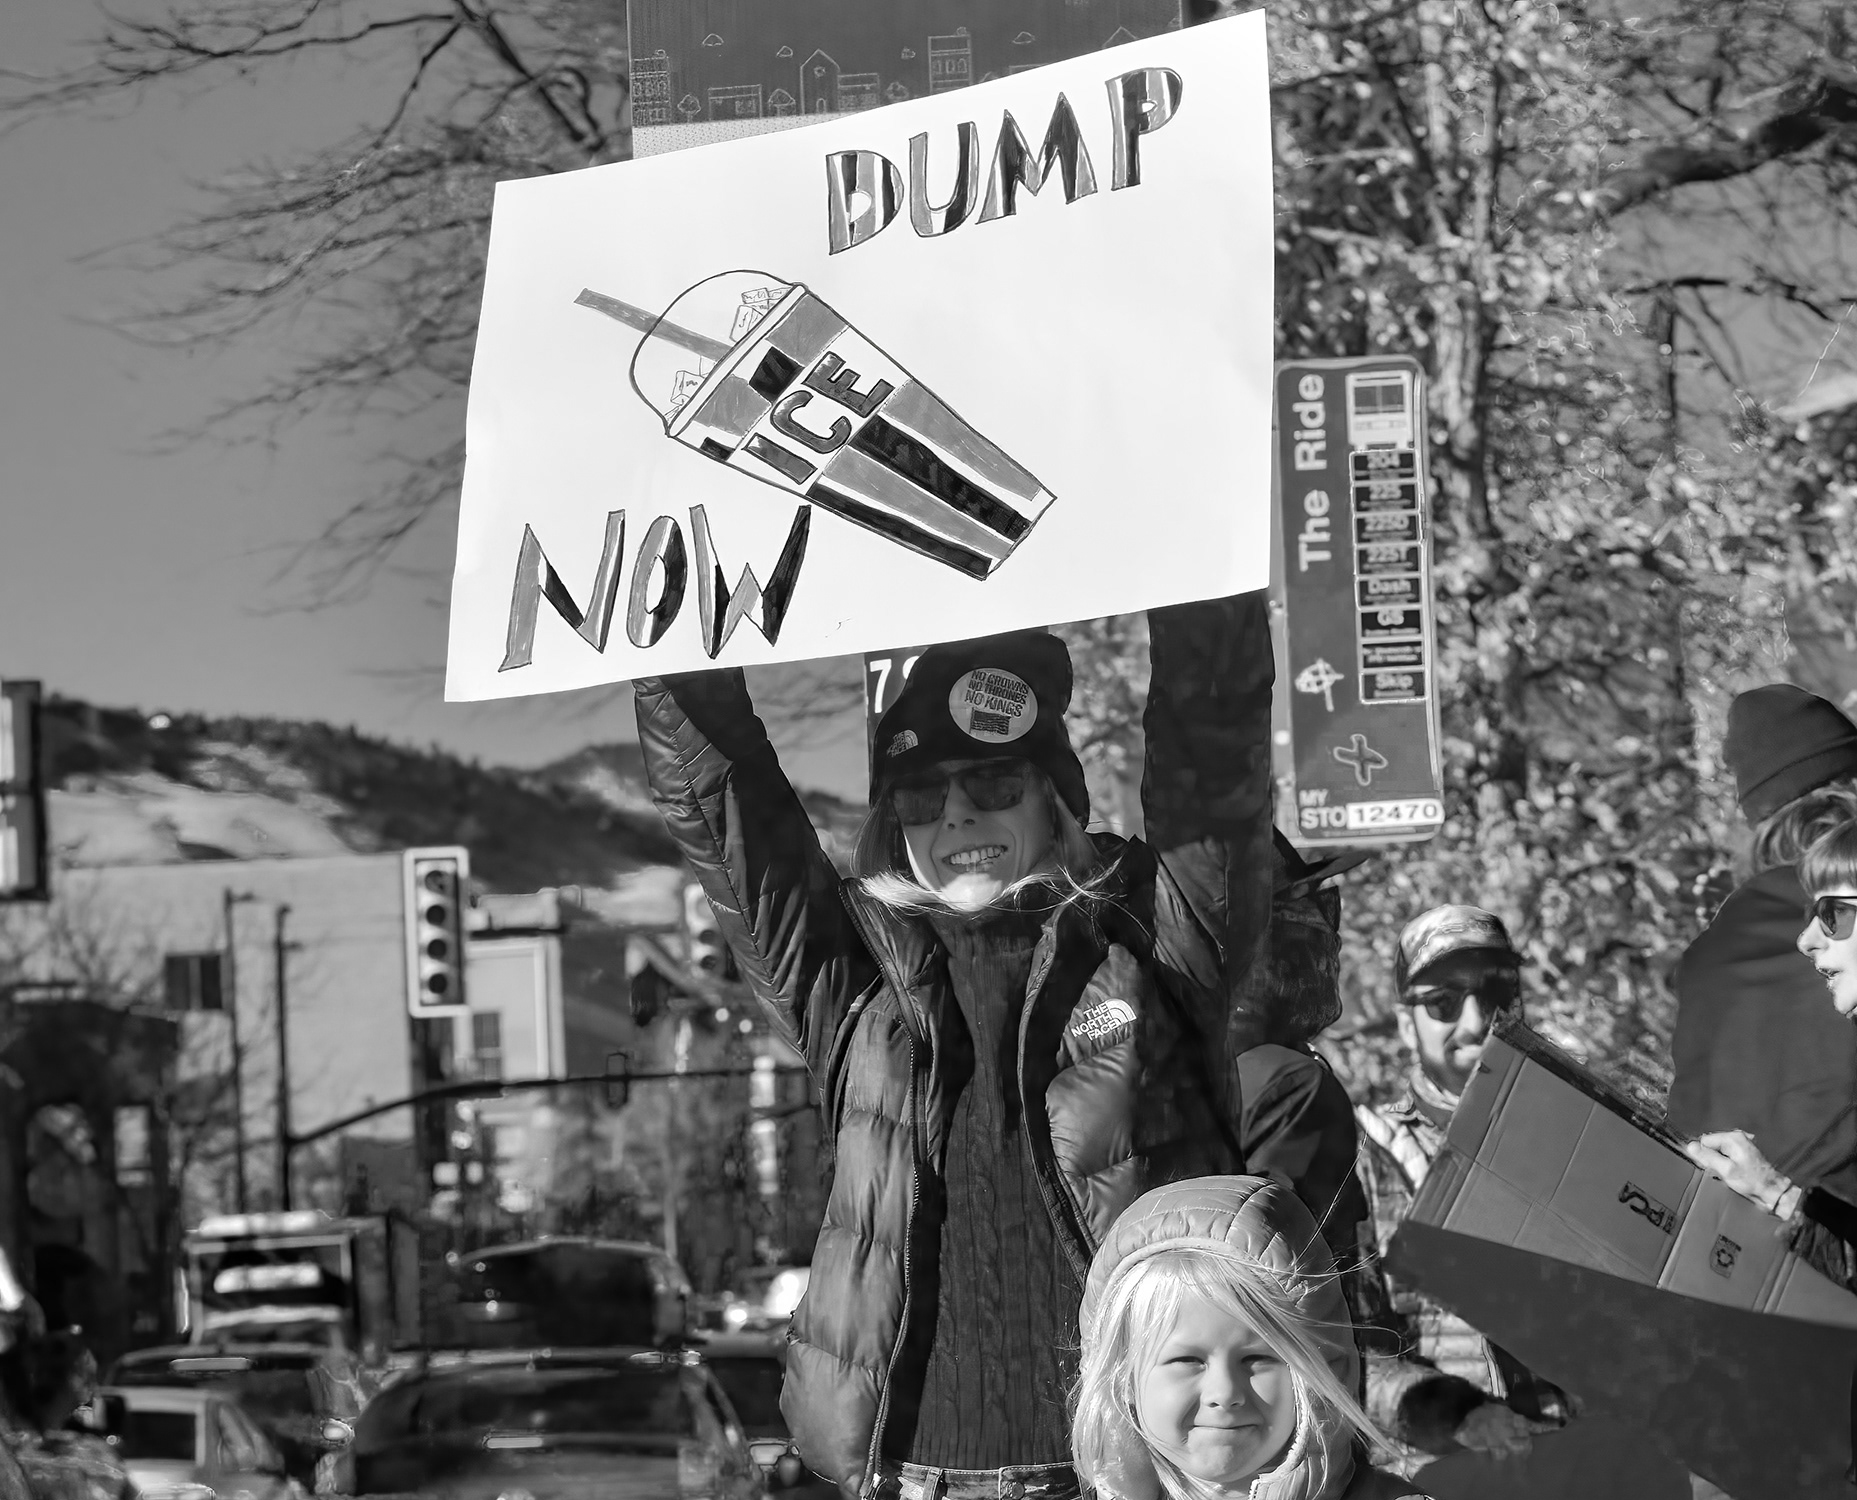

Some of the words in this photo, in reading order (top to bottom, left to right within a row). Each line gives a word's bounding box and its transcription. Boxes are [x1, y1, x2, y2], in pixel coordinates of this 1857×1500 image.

[825, 67, 1183, 255] DUMP
[741, 351, 893, 485] ICE
[1292, 374, 1327, 470] Ride
[1298, 489, 1332, 572] The
[498, 504, 812, 672] NOW
[869, 655, 920, 714] 7
[968, 680, 983, 691] NO
[984, 683, 1027, 705] THRONES
[971, 670, 986, 681] NO
[987, 673, 1028, 694] CROWNS
[965, 689, 984, 705] NO
[984, 695, 1023, 717] KINGS
[1299, 788, 1329, 807] MY
[1354, 803, 1438, 823] 12470
[1071, 1011, 1113, 1037] NORTH
[1083, 1002, 1109, 1020] THE
[1086, 1018, 1119, 1040] FACE
